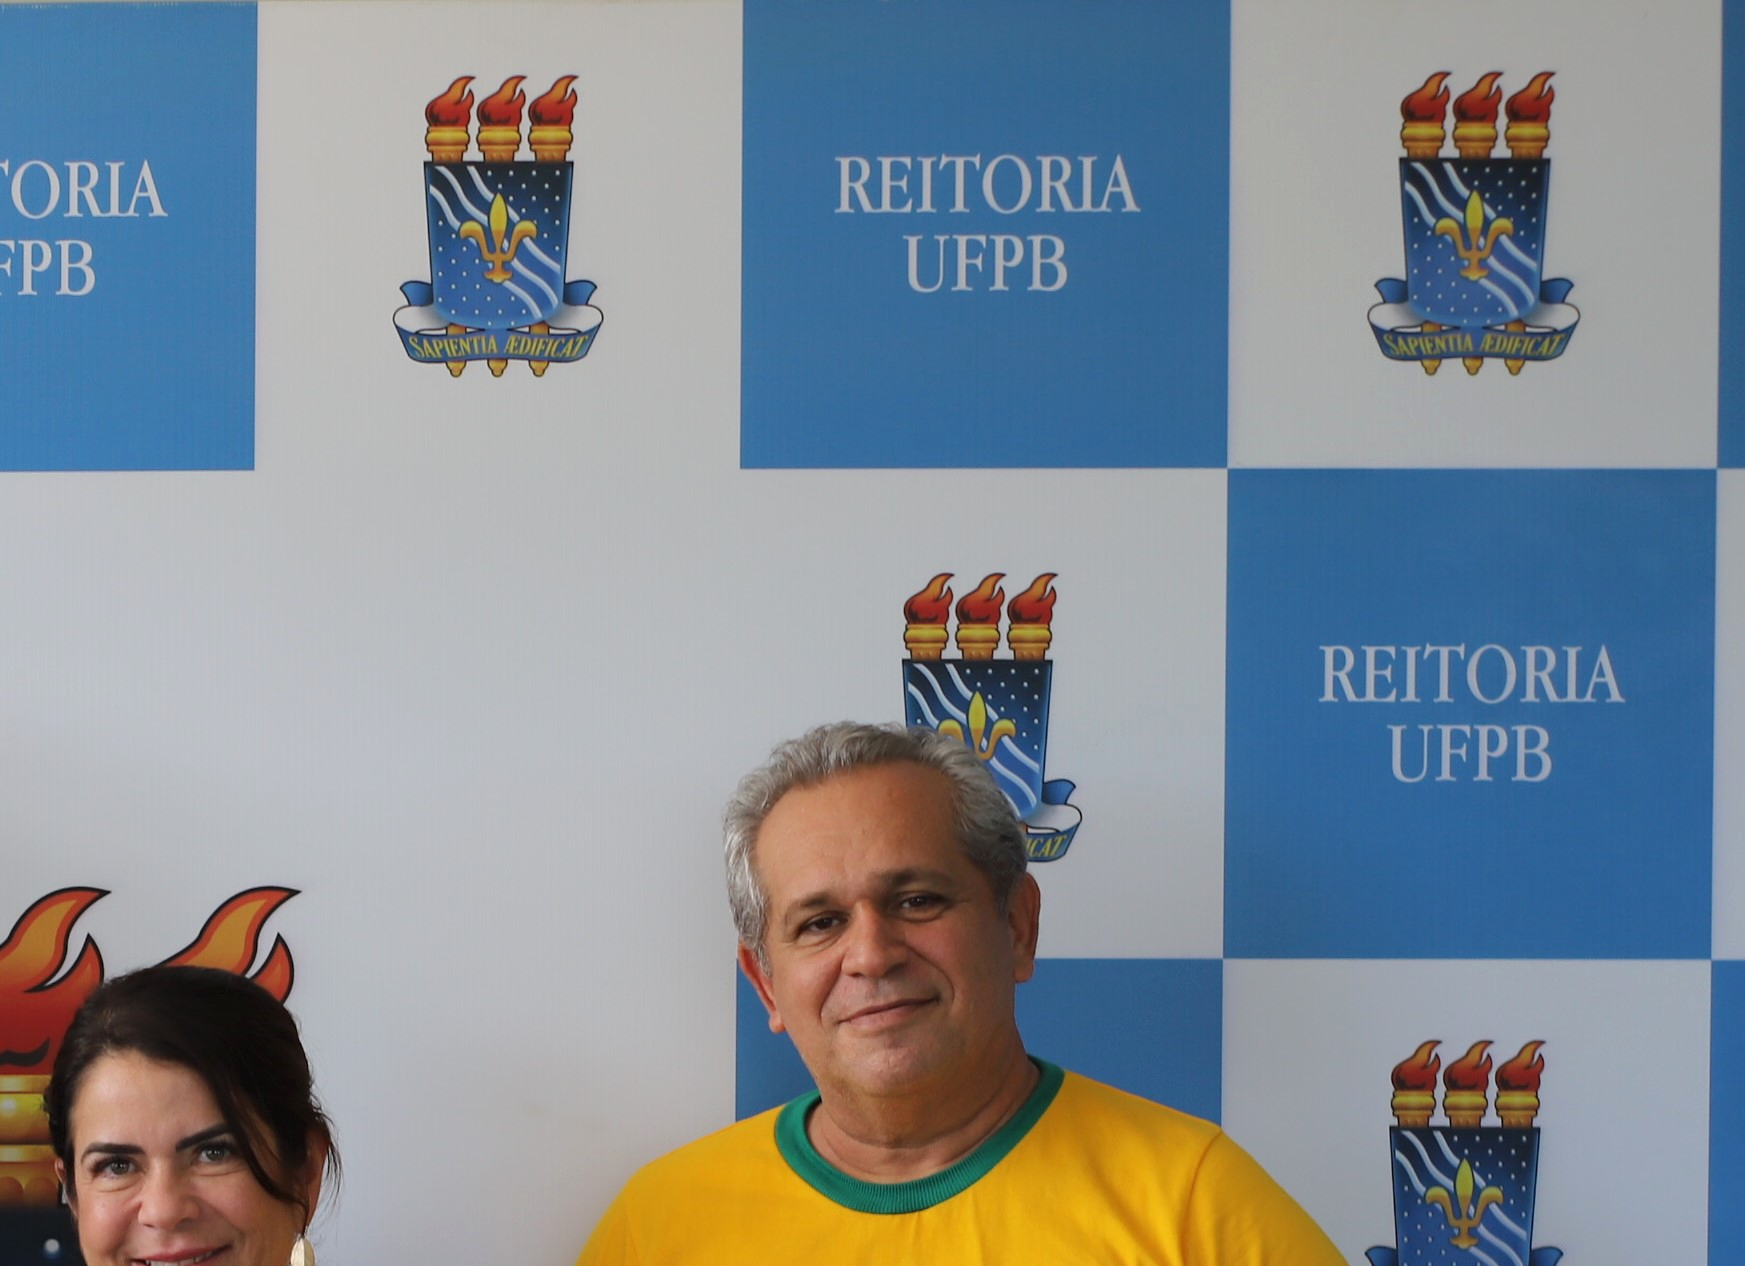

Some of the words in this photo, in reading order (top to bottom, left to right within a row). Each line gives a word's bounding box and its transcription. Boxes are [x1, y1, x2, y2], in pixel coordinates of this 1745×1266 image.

[835, 153, 1140, 214] REITORIA
[903, 234, 1068, 293] UFPB
[408, 335, 498, 358] SAPIENTIA
[1383, 333, 1474, 356] SAPIENTIA
[1319, 643, 1625, 704] REITORIA
[1388, 724, 1552, 783] UFPB
